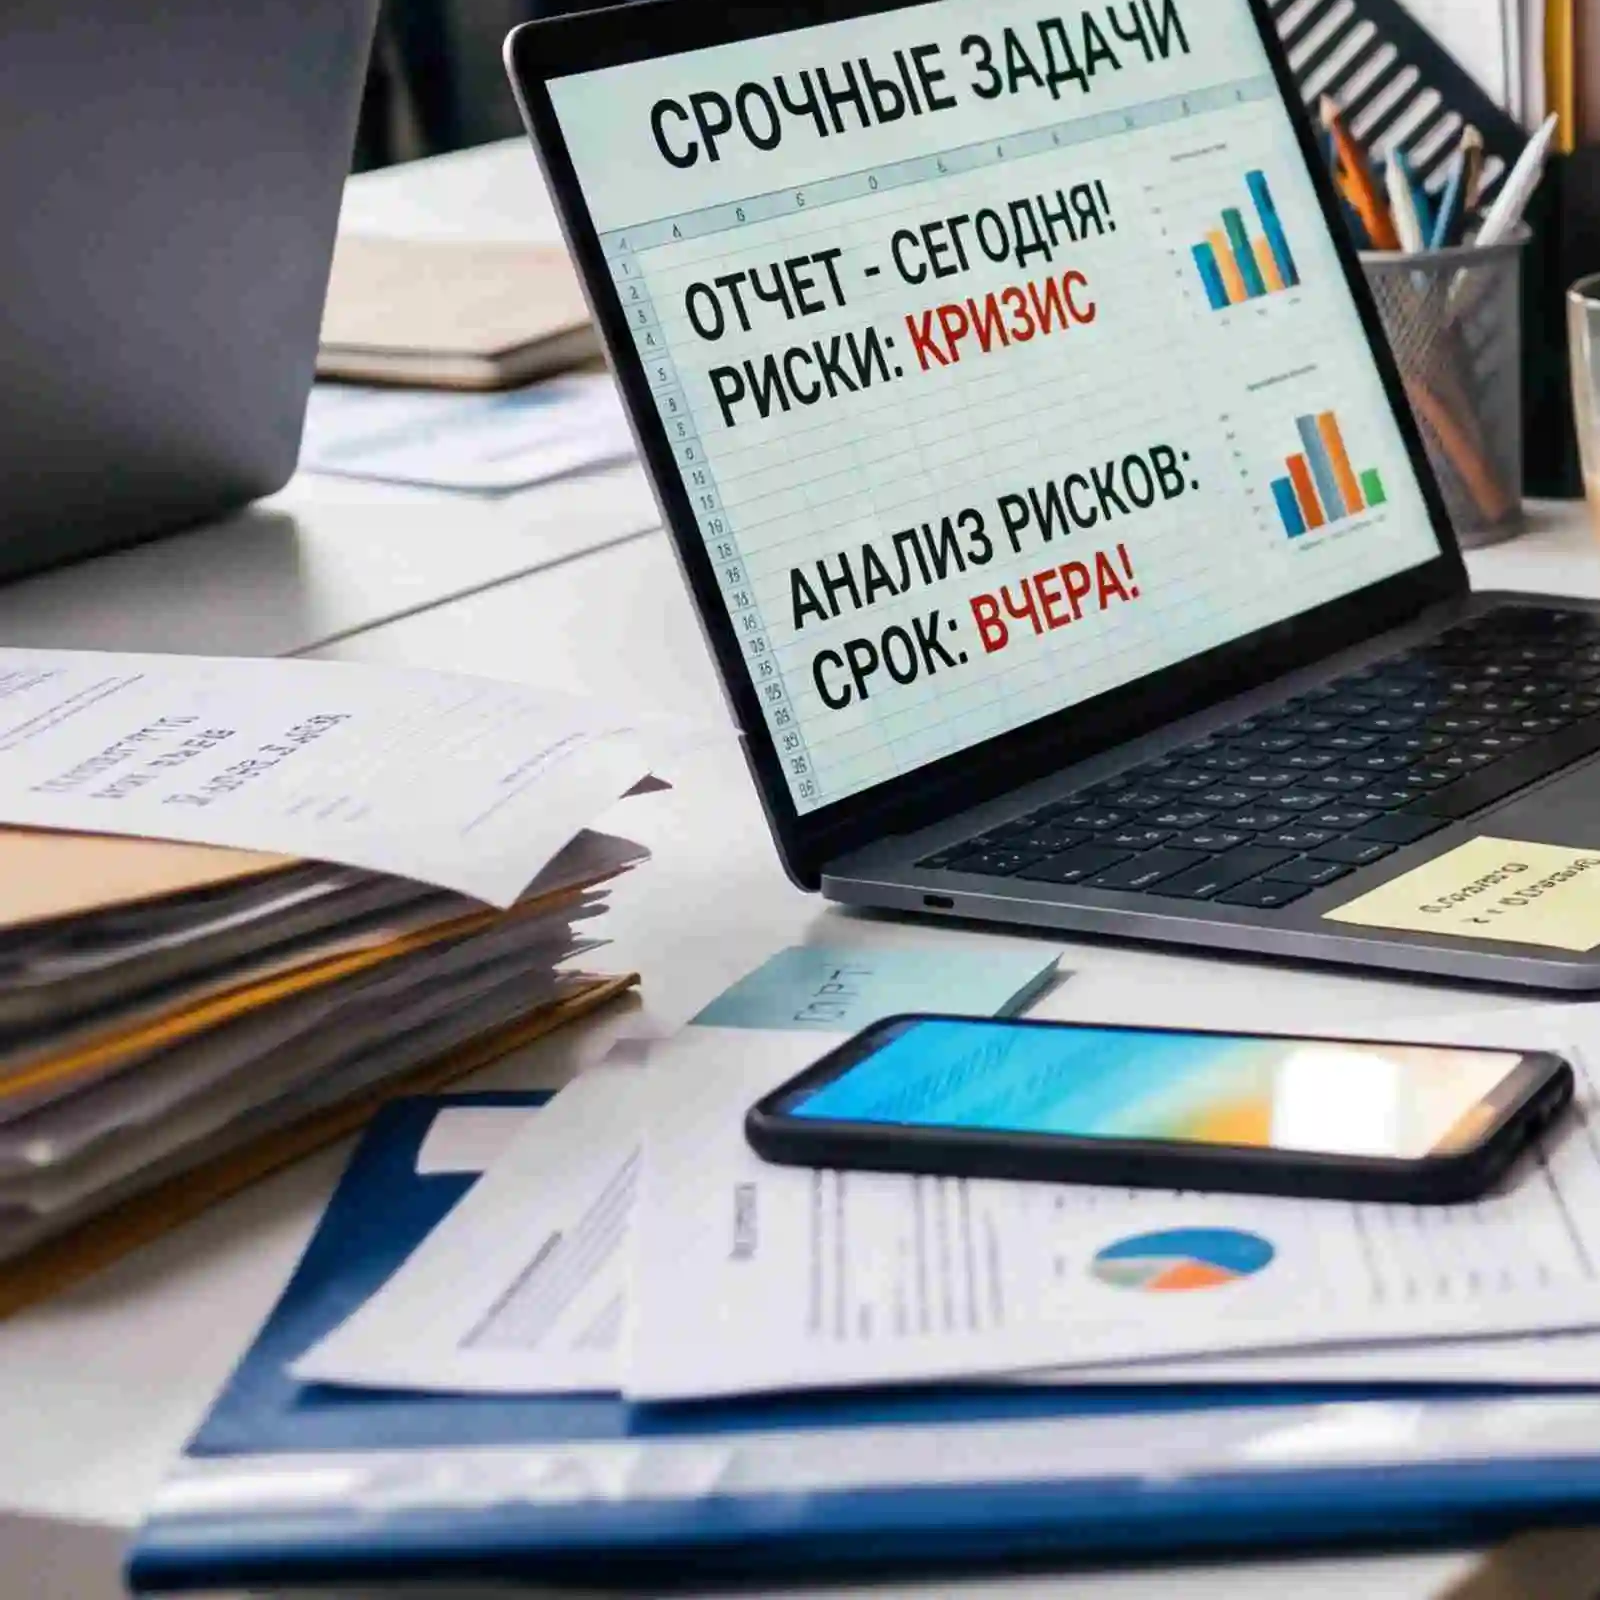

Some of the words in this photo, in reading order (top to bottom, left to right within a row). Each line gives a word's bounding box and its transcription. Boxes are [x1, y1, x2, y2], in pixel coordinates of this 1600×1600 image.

[651, 44, 957, 168] СРОЧНЫЕ
[686, 248, 846, 340] ОТЧЕТ
[892, 180, 1116, 284] СЕГОДНЯ!
[709, 327, 904, 427] РИСКИ:
[906, 272, 1097, 370] КРИЗИС
[791, 509, 992, 630] АНАЛИЗ
[998, 445, 1200, 552] РИСКОВ:
[813, 612, 968, 709] СРОК:
[971, 548, 1140, 653] ВЧЕРА!
